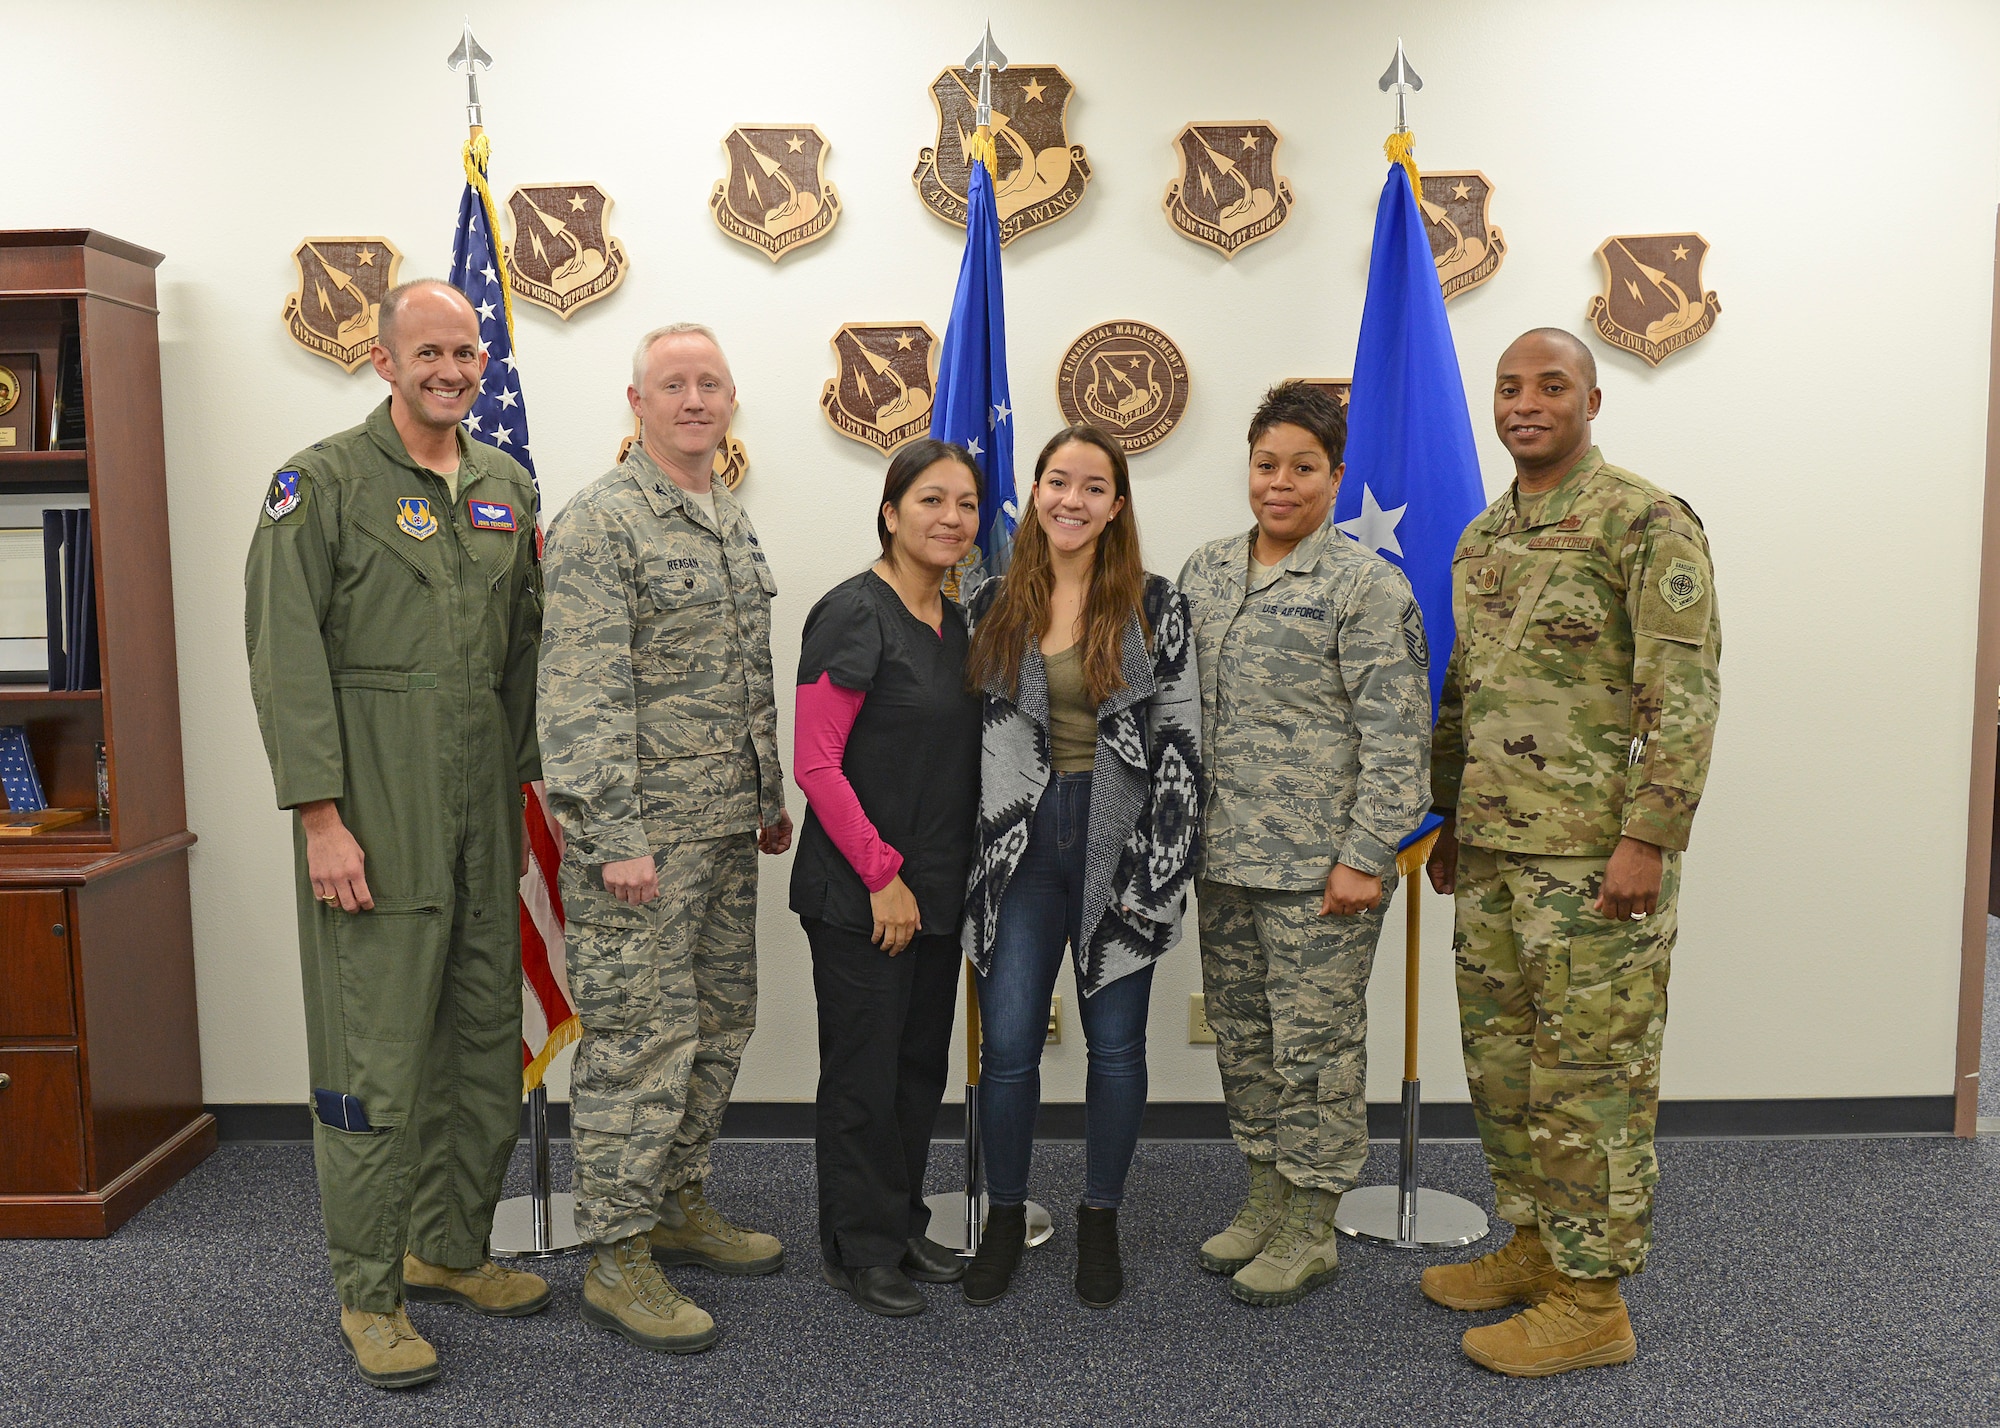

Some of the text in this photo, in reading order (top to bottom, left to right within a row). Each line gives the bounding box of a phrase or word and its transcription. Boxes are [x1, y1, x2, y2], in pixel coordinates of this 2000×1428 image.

[1028, 188, 1078, 223] WING
[721, 209, 828, 252] 412TH MAINTENANCE GROUP
[1176, 208, 1281, 249] USAF TEST PILOT SCHOOL
[1474, 254, 1495, 281] GROUP
[532, 285, 562, 308] MISSION
[563, 283, 593, 309] SUPPORT
[594, 266, 615, 292] GROUP
[294, 321, 320, 348] 412TH
[1064, 327, 1112, 372] FINANCIAL
[1116, 325, 1182, 368] MANAGEMENT
[1620, 331, 1644, 352] CIVIL
[1644, 332, 1686, 360] ENGINEER
[1686, 314, 1710, 342] GROUP
[837, 411, 931, 447] 412TH MEDICAL GROUP
[1120, 418, 1174, 449] PROGRAMS
[1545, 536, 1561, 547] AIR
[1562, 536, 1593, 549] FORCE
[667, 558, 699, 571] REAGAN
[1262, 604, 1278, 615] U.S.
[1295, 606, 1325, 621] FORCE
